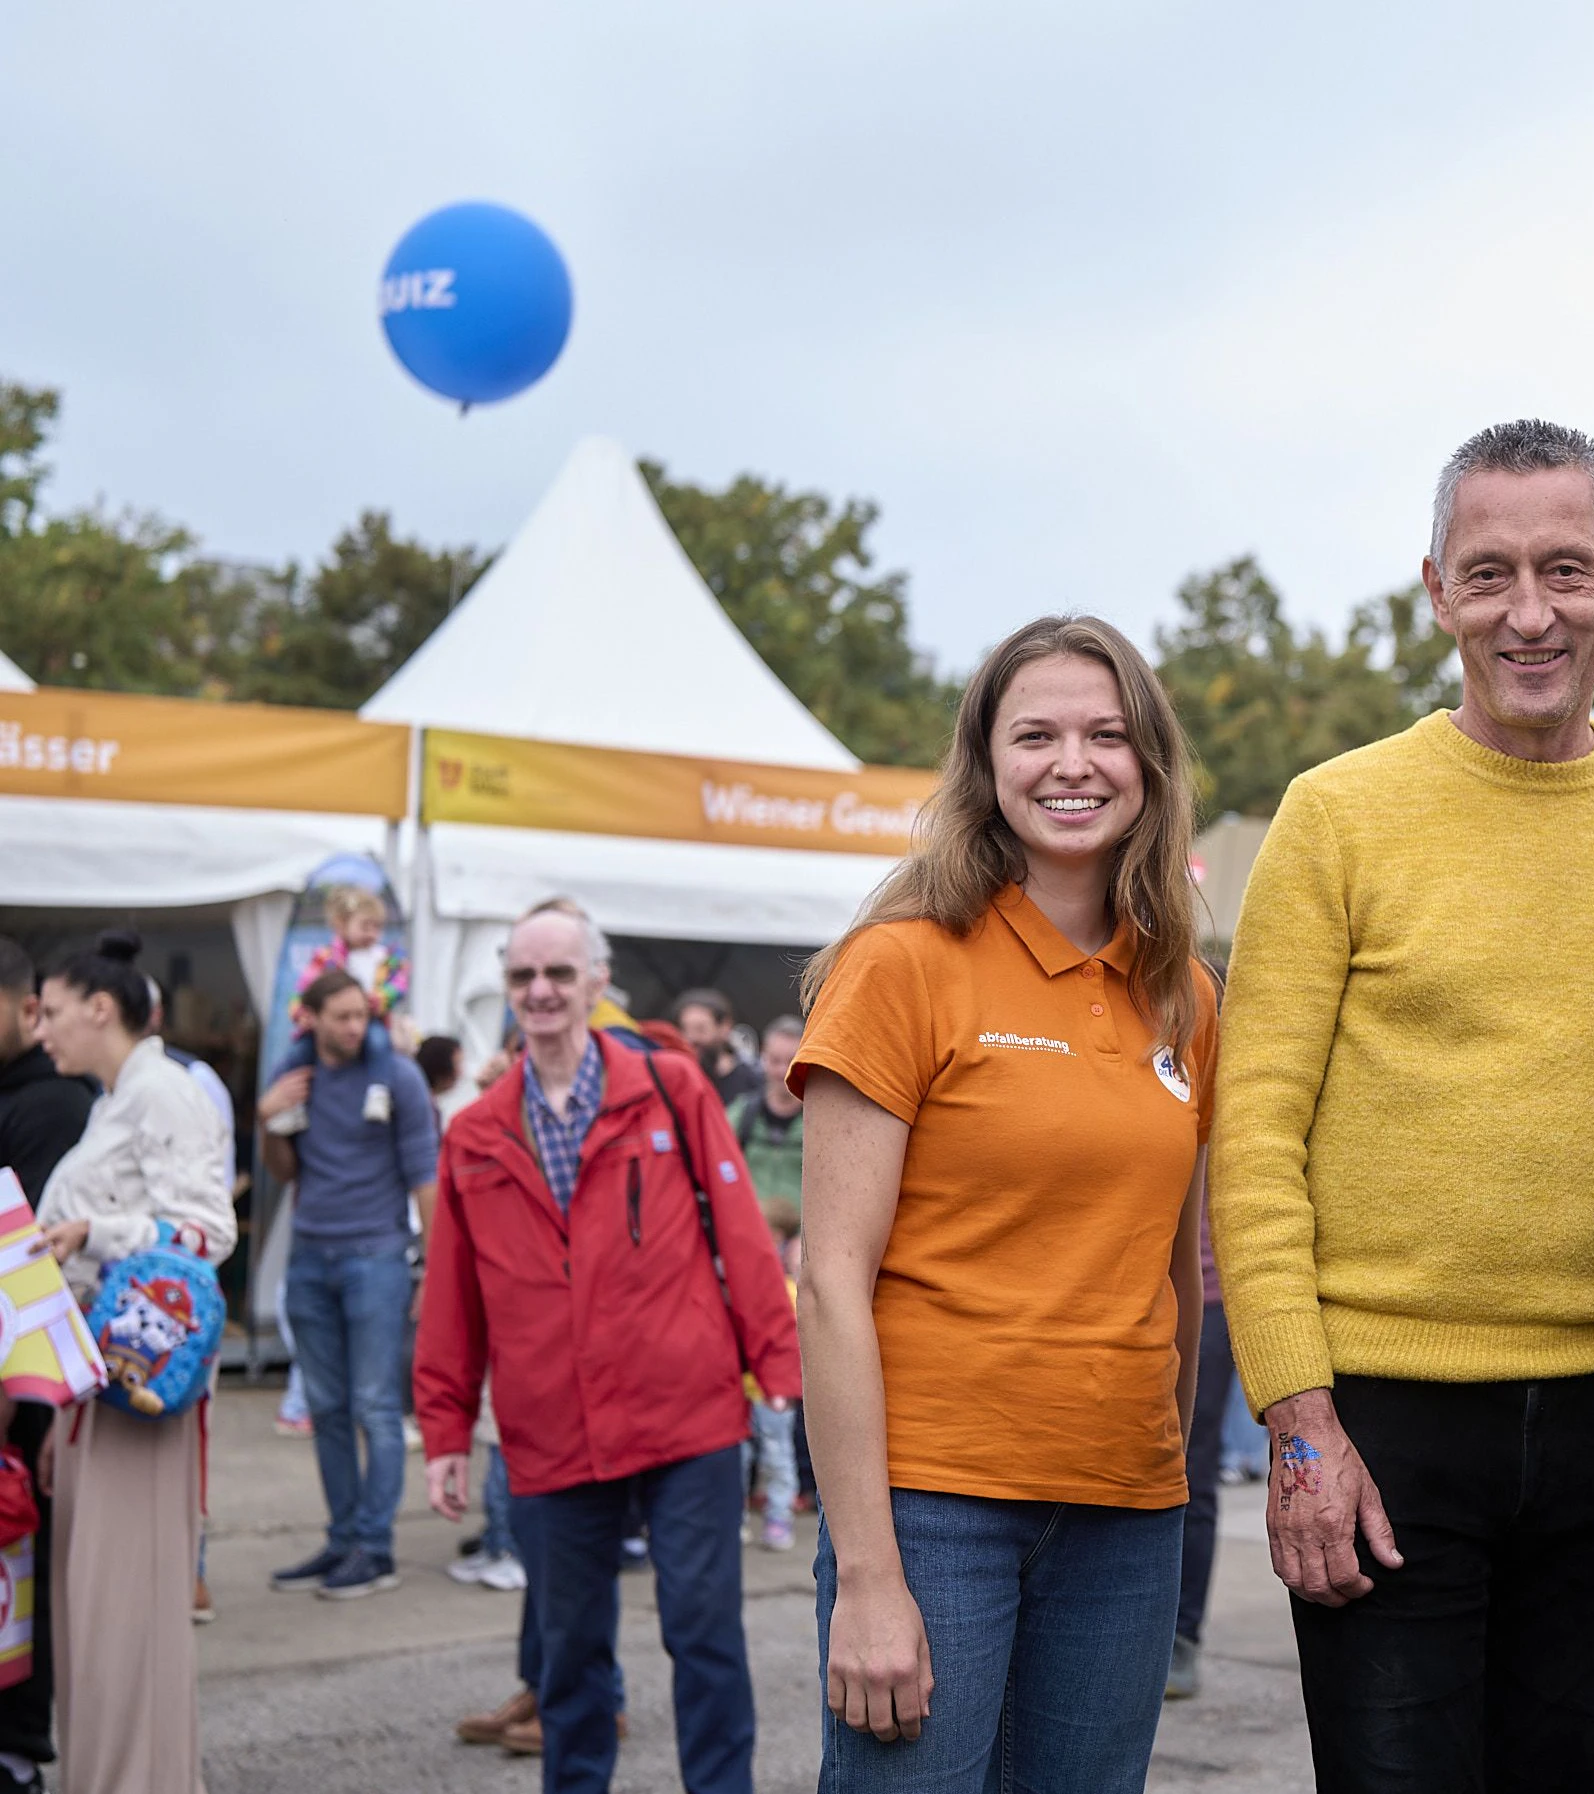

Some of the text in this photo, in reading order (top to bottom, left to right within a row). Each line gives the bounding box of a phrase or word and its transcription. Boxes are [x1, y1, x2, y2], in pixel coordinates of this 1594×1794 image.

[379, 269, 458, 313] UIZ
[701, 779, 826, 832] Wiener
[979, 1032, 1070, 1053] abfallberatung
